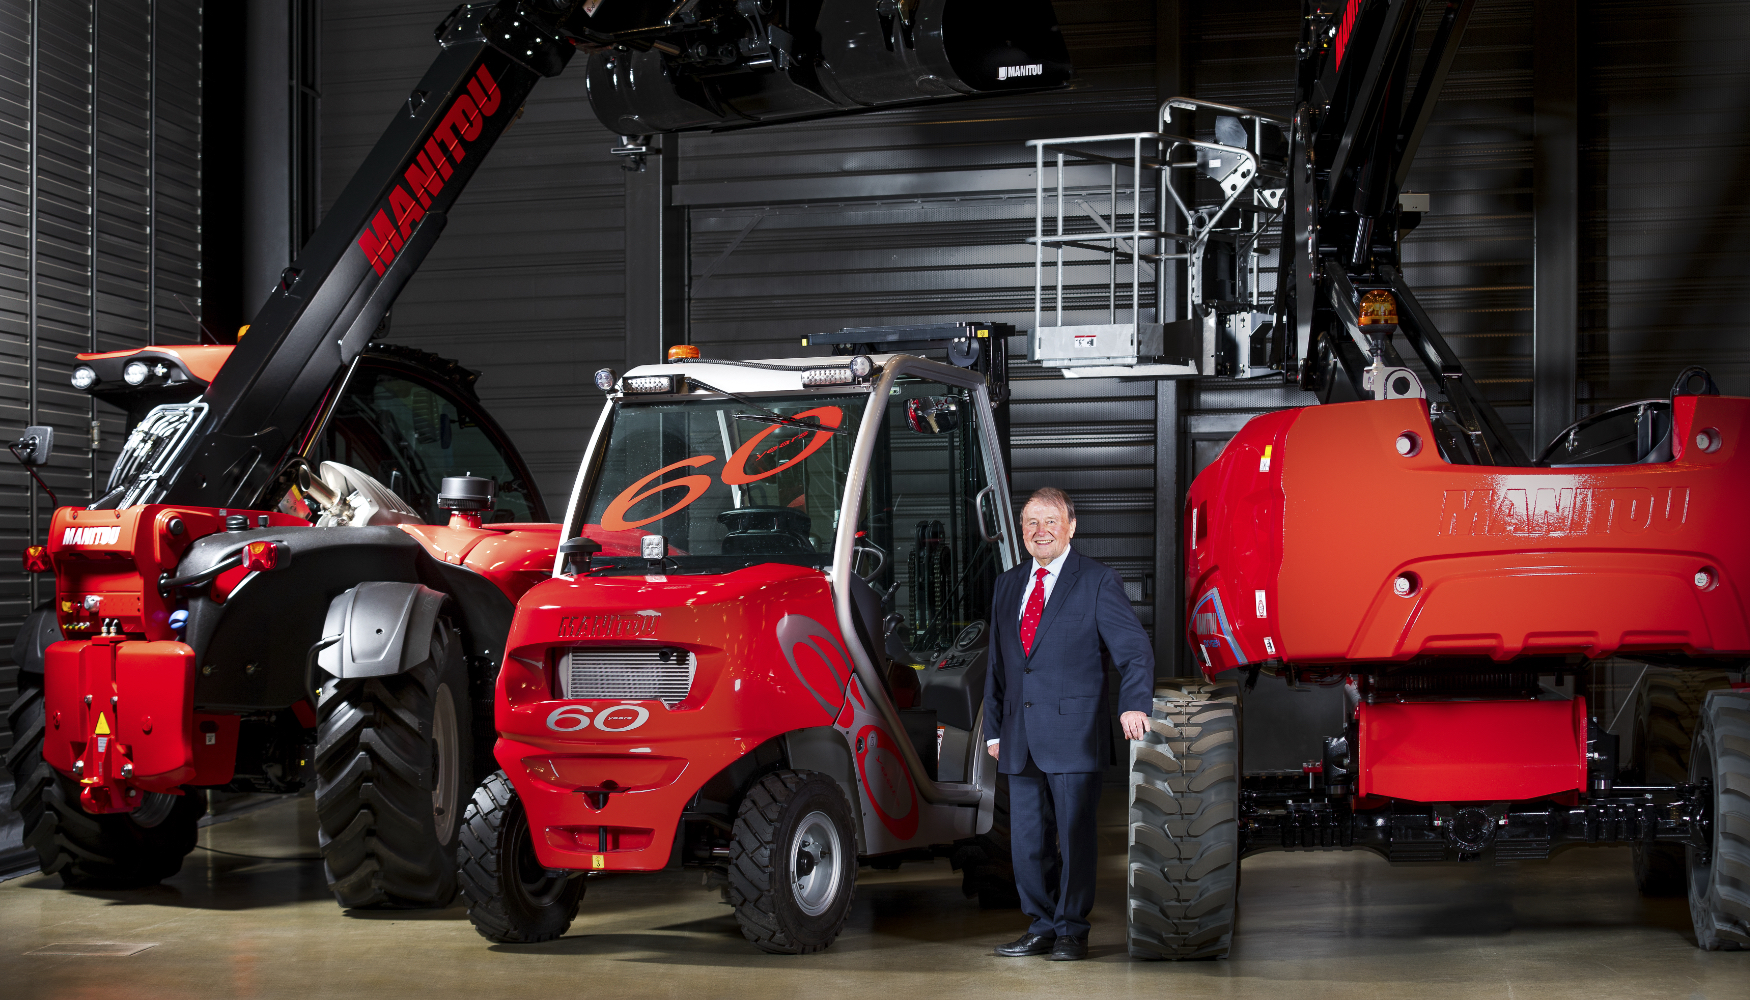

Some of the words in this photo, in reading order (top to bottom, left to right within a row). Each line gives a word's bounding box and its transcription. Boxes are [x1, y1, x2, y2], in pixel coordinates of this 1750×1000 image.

[1007, 63, 1043, 78] MANITOU
[357, 63, 502, 278] MANITOU
[755, 430, 809, 461] years
[600, 405, 843, 532] 60
[1438, 486, 1690, 536] MANITOU
[62, 526, 122, 545] MANITOU
[558, 614, 661, 637] MANITOU
[546, 704, 650, 732] 60
